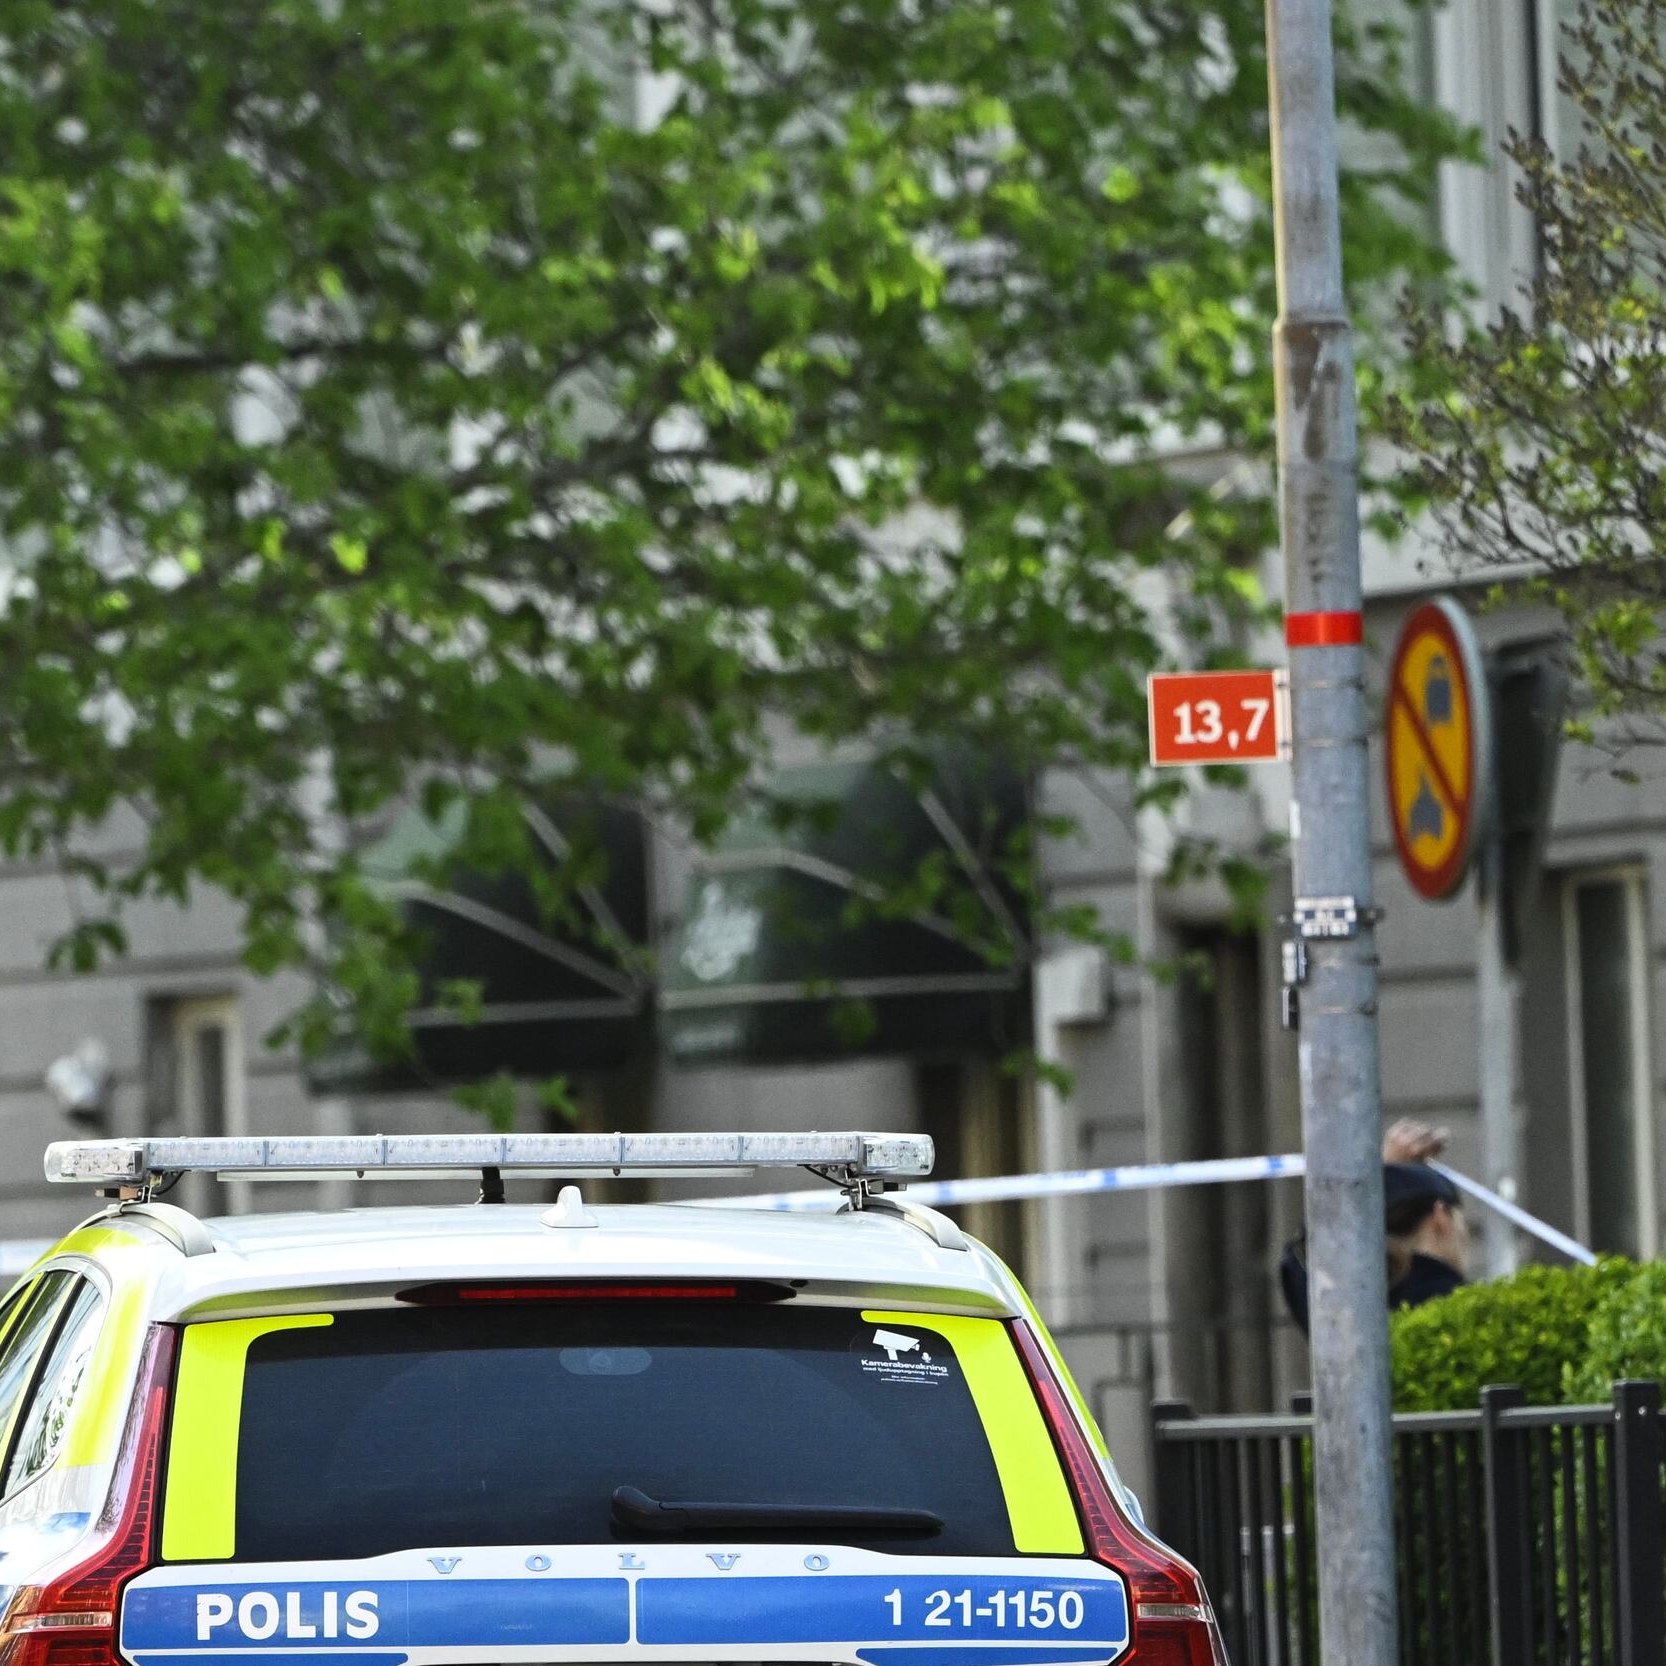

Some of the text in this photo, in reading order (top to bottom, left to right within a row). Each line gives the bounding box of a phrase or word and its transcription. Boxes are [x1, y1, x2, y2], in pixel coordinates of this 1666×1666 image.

[1173, 699, 1270, 751] 13,7
[861, 1359, 948, 1373] Kamerabevakning
[427, 1551, 831, 1575] VOLVO
[196, 1590, 380, 1641] POLIS
[884, 1588, 1084, 1630] 1 21-1150
